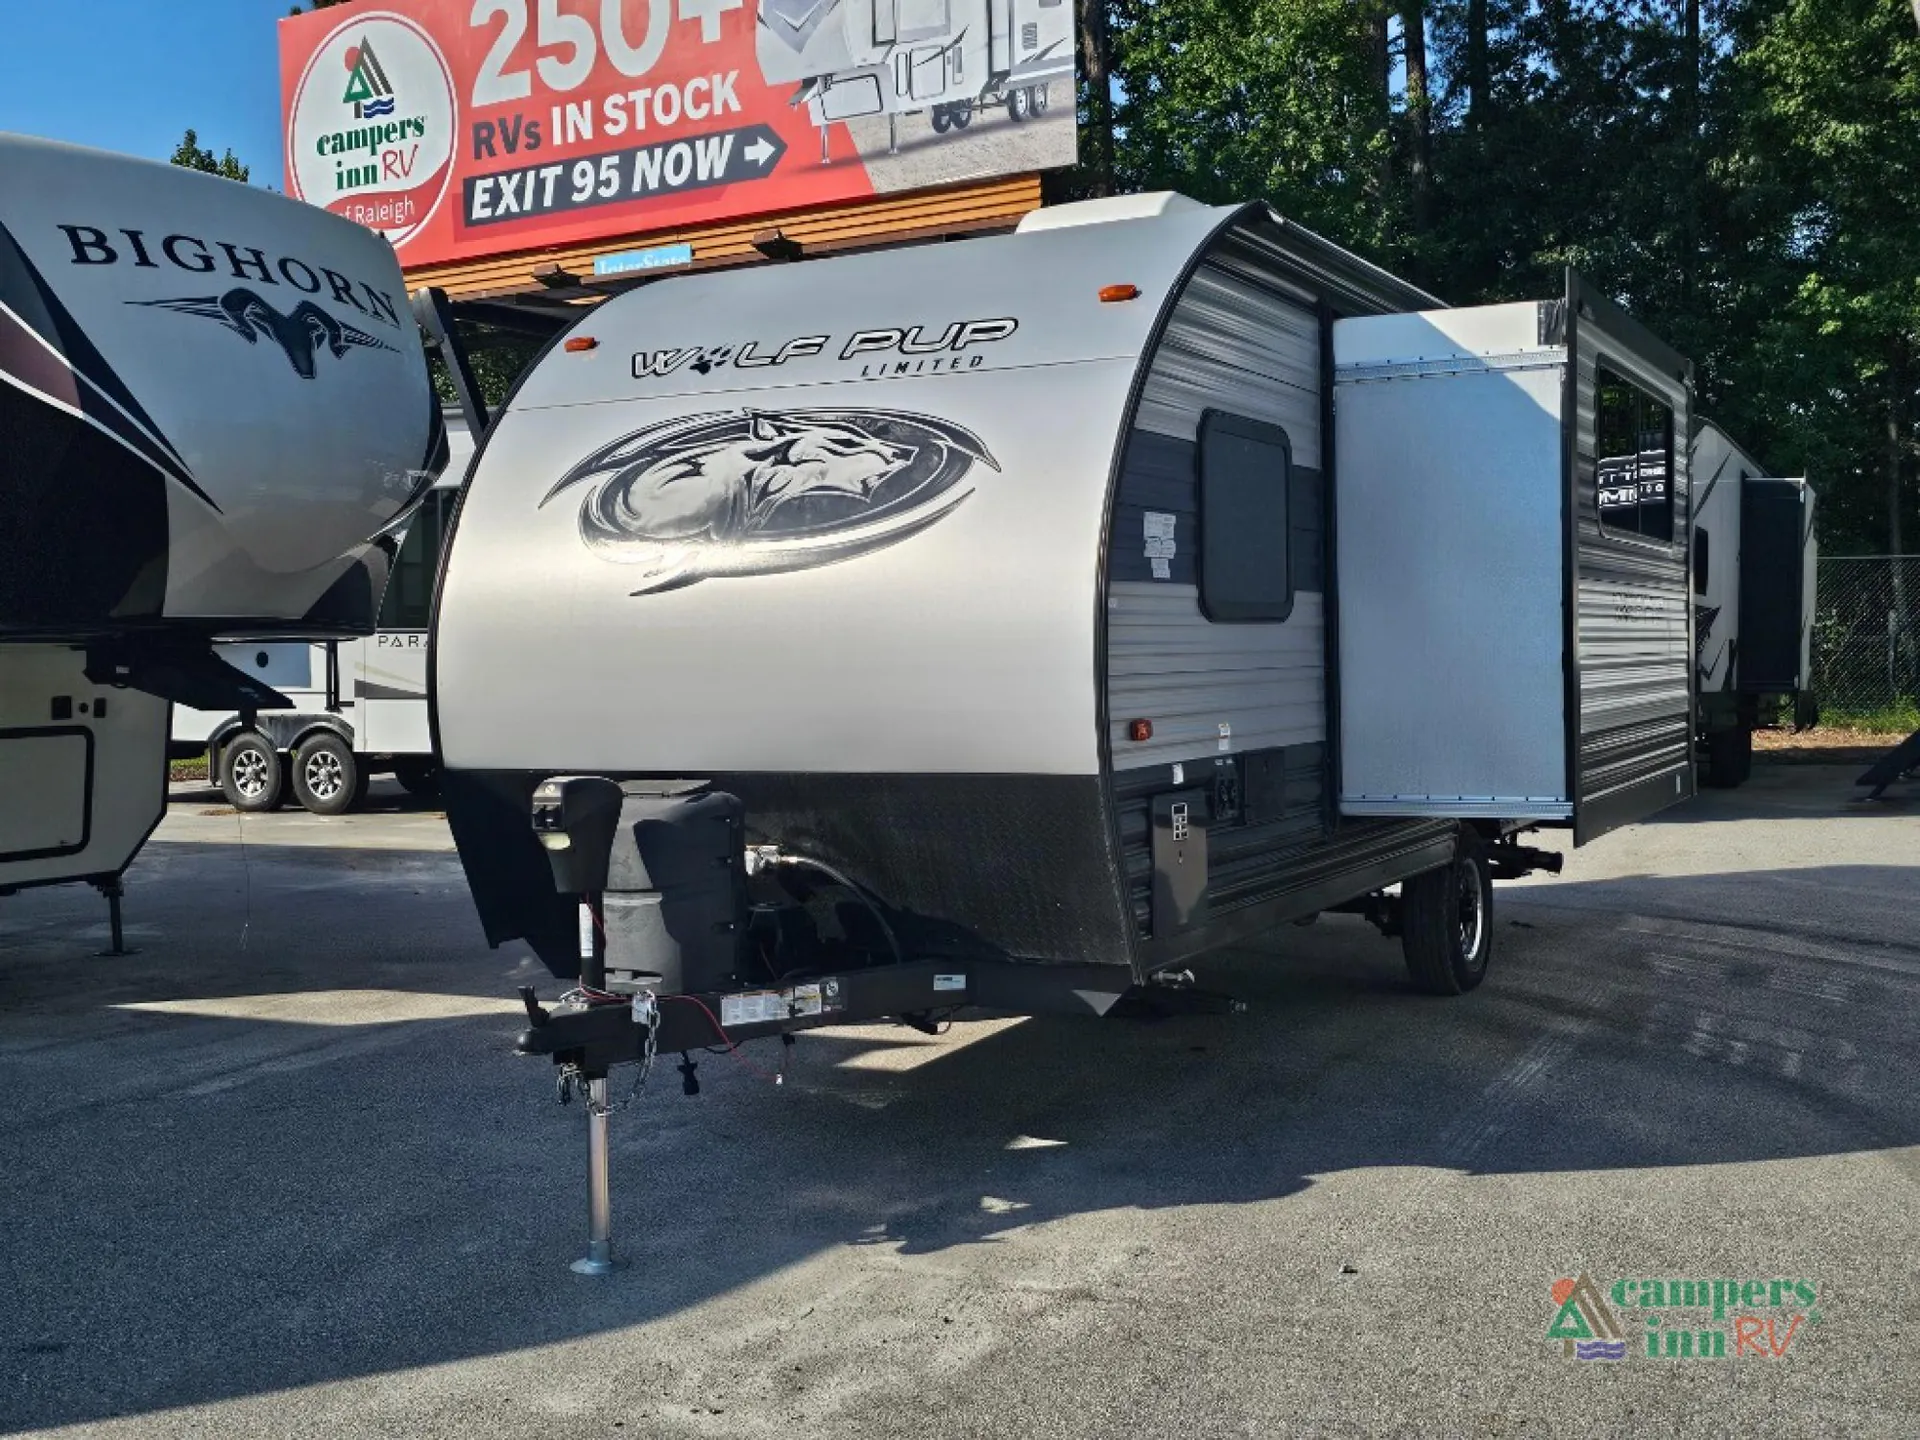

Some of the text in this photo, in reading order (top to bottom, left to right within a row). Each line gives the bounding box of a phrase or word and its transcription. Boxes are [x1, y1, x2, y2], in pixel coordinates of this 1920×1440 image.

[470, 0, 743, 107] 250+
[316, 115, 425, 156] campers
[471, 69, 741, 160] RVs IN STOCK
[336, 143, 419, 191] inn RV
[471, 134, 735, 220] EXIT 95 NOW
[355, 194, 415, 223] Raleigh
[57, 224, 401, 330] BIGHORN
[838, 316, 1018, 361] PUP
[860, 355, 984, 377] LIMITED
